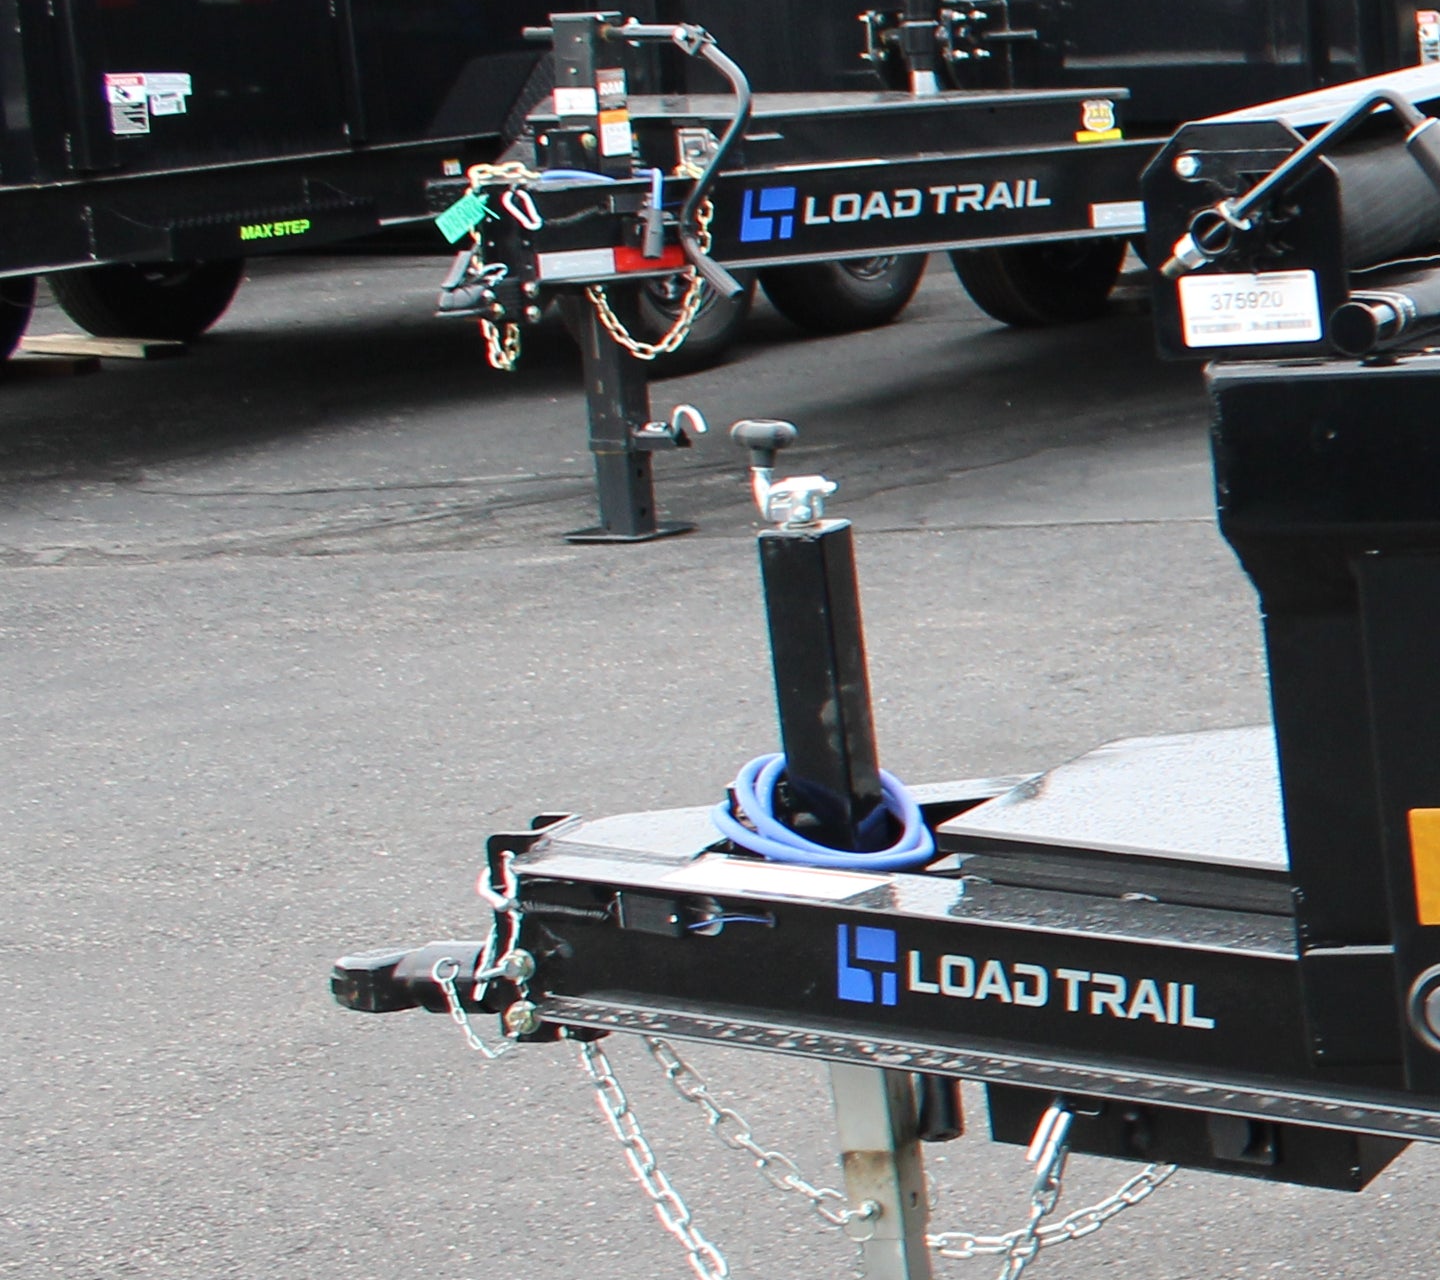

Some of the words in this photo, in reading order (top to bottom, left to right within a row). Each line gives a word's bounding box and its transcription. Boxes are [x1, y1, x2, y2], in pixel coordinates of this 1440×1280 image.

[803, 188, 922, 225] LOAD
[929, 178, 1051, 214] TRAIL
[240, 224, 273, 240] MAX
[273, 219, 310, 236] STEP
[1211, 290, 1284, 311] 375920
[908, 950, 1050, 1007] LOAD
[1056, 968, 1216, 1030] TRAIL
